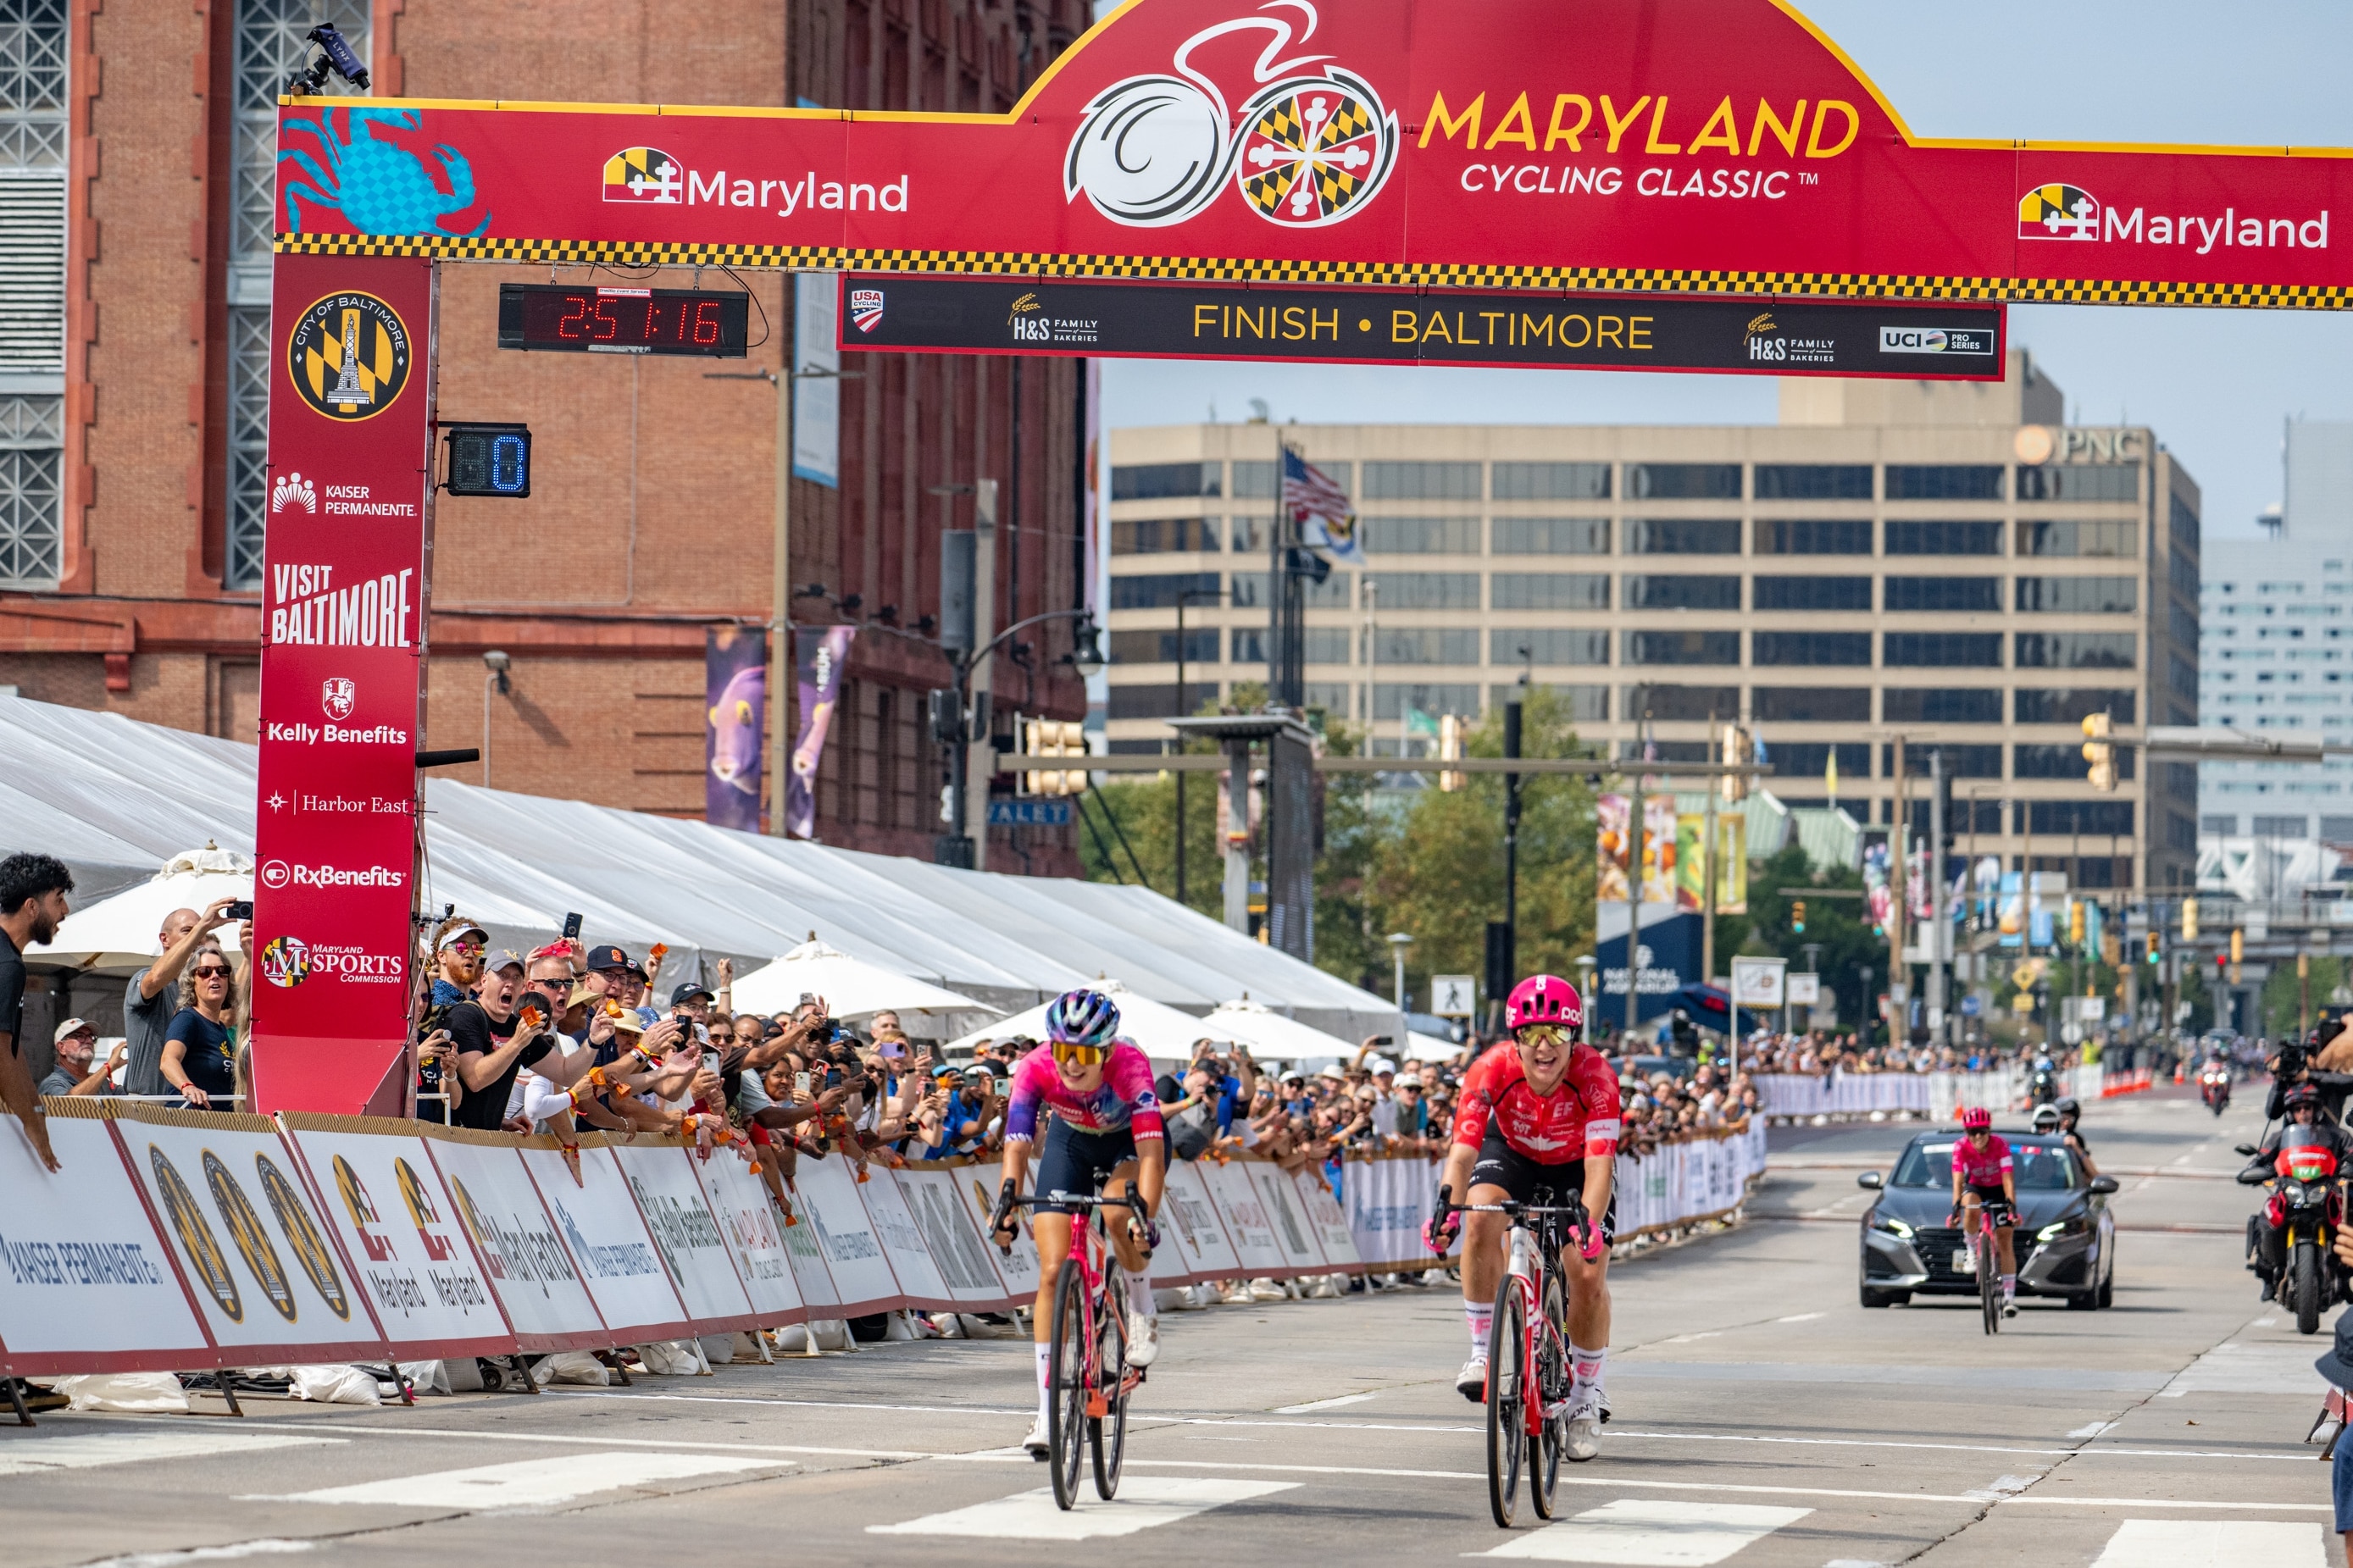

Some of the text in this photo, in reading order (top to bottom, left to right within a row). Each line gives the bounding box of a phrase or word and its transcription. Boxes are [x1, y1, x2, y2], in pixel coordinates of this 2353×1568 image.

[332, 42, 350, 62] LYNX
[1418, 88, 1861, 158] MARYLAND
[1461, 163, 1623, 196] CYCLING
[1636, 169, 1790, 200] CLASSIC
[688, 170, 908, 218] Maryland
[2105, 206, 2329, 254] Maryland
[853, 291, 882, 302] USA
[296, 296, 406, 352] CITY OF BALTIMORE
[1014, 317, 1050, 341] H&S
[1054, 319, 1098, 329] FAMILY
[1194, 304, 1654, 351] FINISH BALTIMORE
[1750, 337, 1786, 361] H&S
[1790, 339, 1834, 349] FAMILY
[1885, 332, 1922, 348] UCI
[1951, 334, 1969, 342] PRO
[1951, 341, 1980, 350] SERIES
[1790, 354, 1834, 363] BAKERIES
[2062, 428, 2142, 463] PNC
[493, 435, 525, 491] 0
[325, 485, 370, 500] KAISER
[273, 563, 333, 605] VISIT
[272, 568, 413, 648] BALTIMORE
[268, 723, 407, 745] Kelly Benefits
[302, 795, 408, 814] Harbor East
[312, 944, 363, 955] MARYLAND
[312, 956, 402, 975] SPORTS
[340, 972, 401, 984] COMMISSION
[9, 1241, 69, 1285] KAISER
[482, 1212, 576, 1300] Maryland
[367, 1266, 486, 1319] Maryland Maryland
